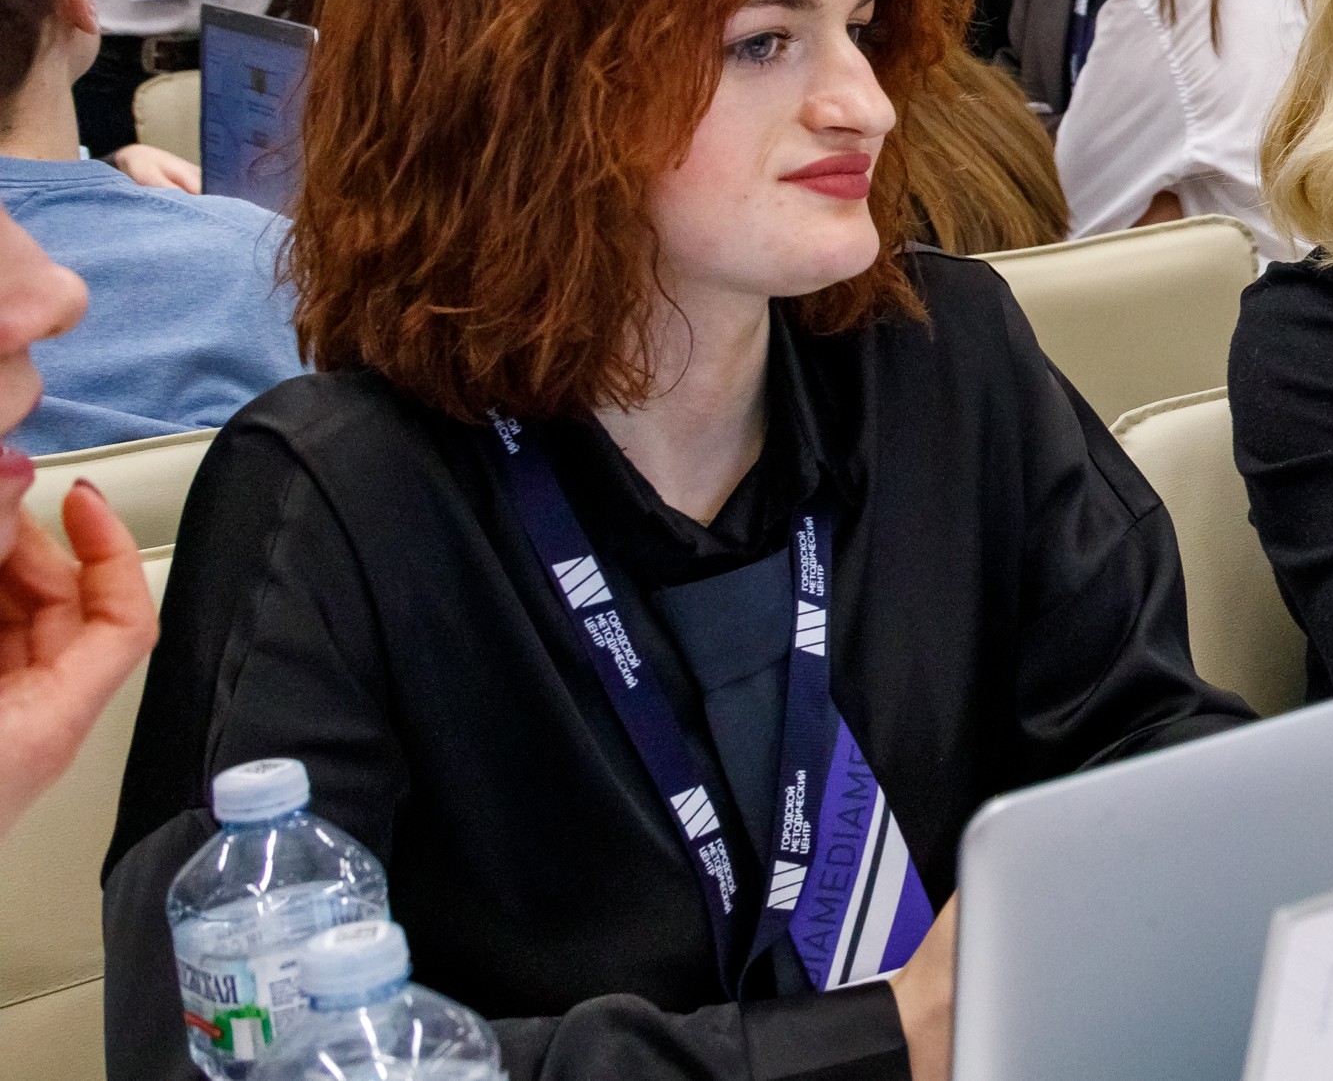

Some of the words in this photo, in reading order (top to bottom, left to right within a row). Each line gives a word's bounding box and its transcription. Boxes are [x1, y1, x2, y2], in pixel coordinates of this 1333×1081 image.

[797, 531, 808, 591] ГОРОДСКОЙ
[804, 517, 818, 594] МЕТОДИЧЕСКИЙ
[816, 565, 824, 596] ЦЕНТР
[584, 617, 607, 648] ЦЕНТР
[595, 613, 638, 689] МЕТОДИЧЕСКИЙ
[606, 610, 641, 670] ГОРОДСКОЙ
[781, 785, 796, 851] ГОРОДСКОЙ
[790, 769, 806, 853] МЕТОДИЧЕСКИЙ
[800, 821, 811, 854] ЦЕНТР
[698, 846, 716, 877] ЦЕНТР
[708, 841, 733, 915] МЕТОДИЧЕСКИЙ
[715, 837, 737, 895] ГОРОДСКОЙ
